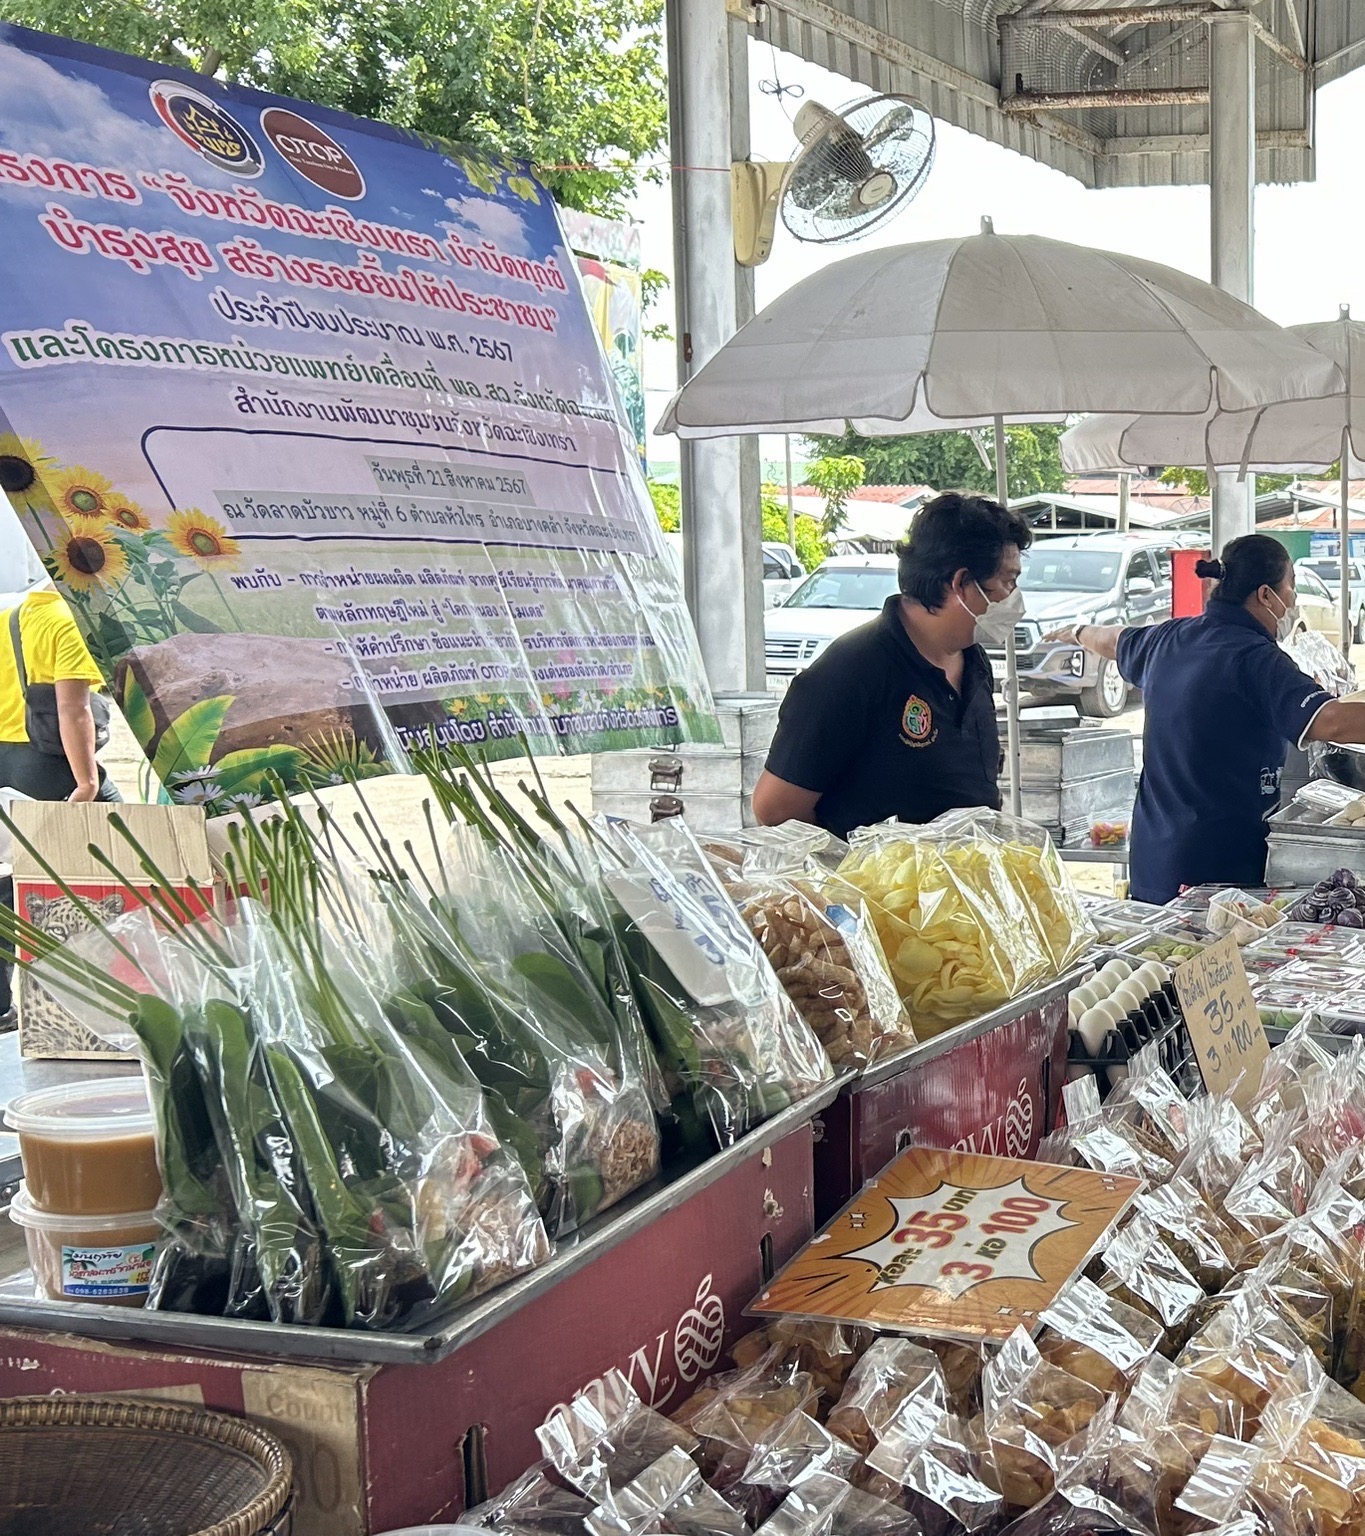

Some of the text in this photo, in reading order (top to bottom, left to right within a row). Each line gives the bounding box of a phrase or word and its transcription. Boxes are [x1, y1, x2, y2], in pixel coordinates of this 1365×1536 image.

[275, 133, 343, 164] OTOP
[45, 207, 556, 332] บำรุงสุข สร้างรอยยิ้มให้ประชาชน”
[449, 234, 567, 292] บำบัดทุกข์
[213, 290, 513, 362] ประจำปีงบประมาณ พ.ศ. 2567
[10, 325, 447, 392] และโครงการหน่วยแพทย์เคลื่อนที่
[372, 459, 528, 495] วันพุธที่ 21 สิงหาคม 2567
[223, 502, 246, 519] ณ
[357, 495, 394, 529] หมู่ที่
[395, 505, 408, 523] 6
[410, 503, 486, 528] ตำบลหัวไทร
[489, 509, 564, 534] อำเภอบางคล้า
[230, 567, 282, 590] พบกับ
[418, 568, 467, 587] ผลิตภัณฑ์
[431, 598, 442, 624] สู่
[423, 661, 479, 686] ผลิตภัณฑ์
[481, 664, 510, 679] OTOP
[1204, 989, 1234, 1036] 35
[1206, 1045, 1222, 1073] 3
[1231, 1018, 1254, 1056] 100
[891, 1209, 971, 1249] 35
[942, 1188, 979, 1212] บาท
[939, 1260, 994, 1281] 3
[978, 1196, 1051, 1235] 100
